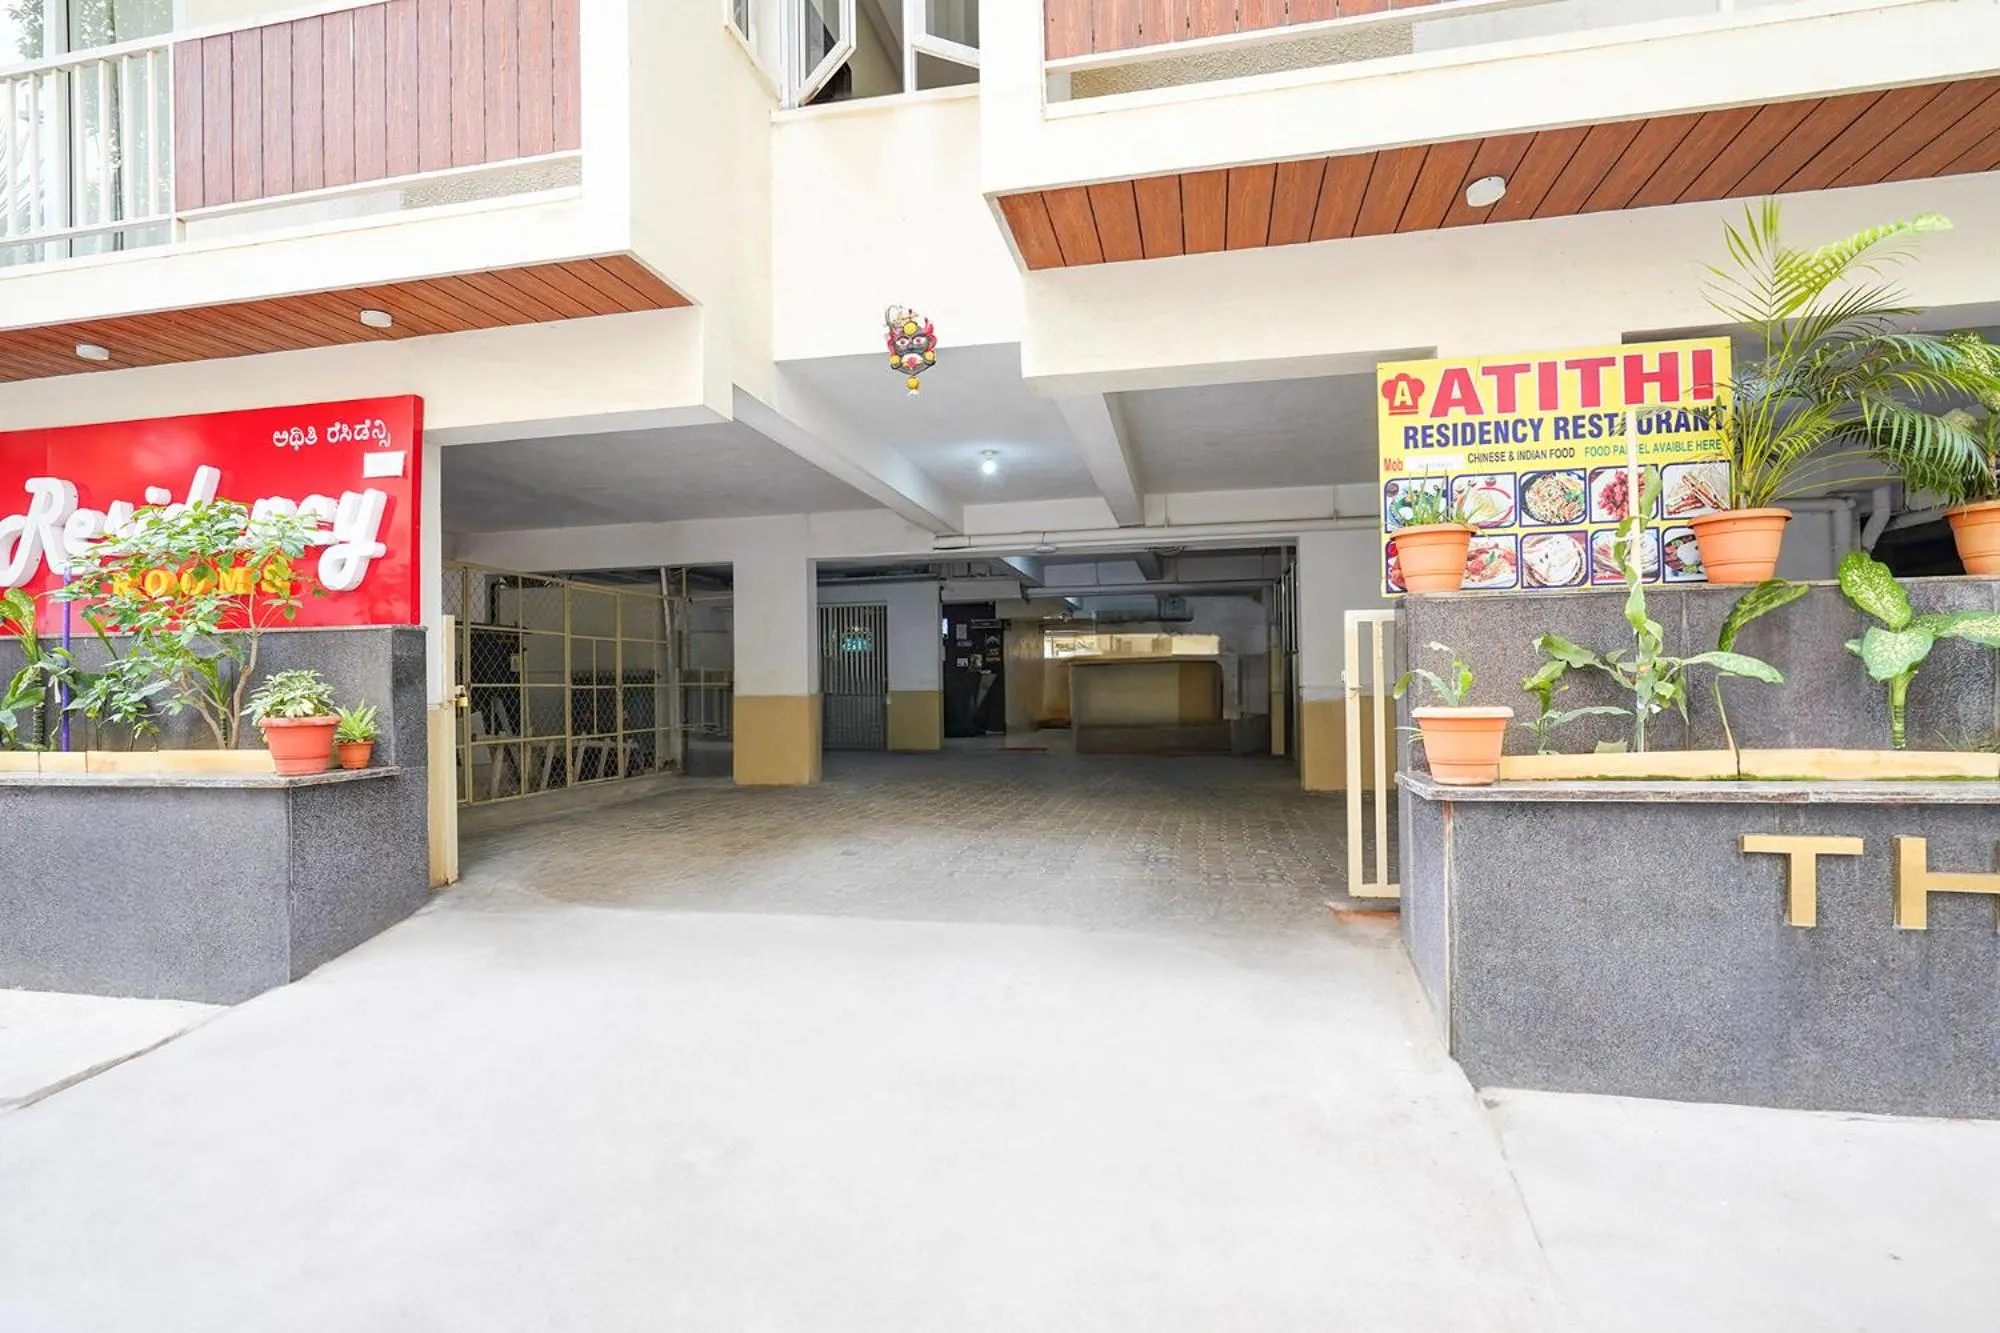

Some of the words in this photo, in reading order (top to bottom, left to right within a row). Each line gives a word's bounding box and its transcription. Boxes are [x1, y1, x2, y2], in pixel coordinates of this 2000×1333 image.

[1430, 349, 1714, 418] ATITHI
[1403, 418, 1544, 449] RESIDENCY
[1467, 452, 1506, 464] CHINESE
[1508, 452, 1515, 462] &
[1517, 450, 1548, 461] INDIAN
[1550, 447, 1575, 459] FOOD
[1584, 445, 1609, 457] FOOD
[1613, 443, 1650, 455] PAEL
[1696, 439, 1722, 451] HERE
[1384, 458, 1403, 471] Mob
